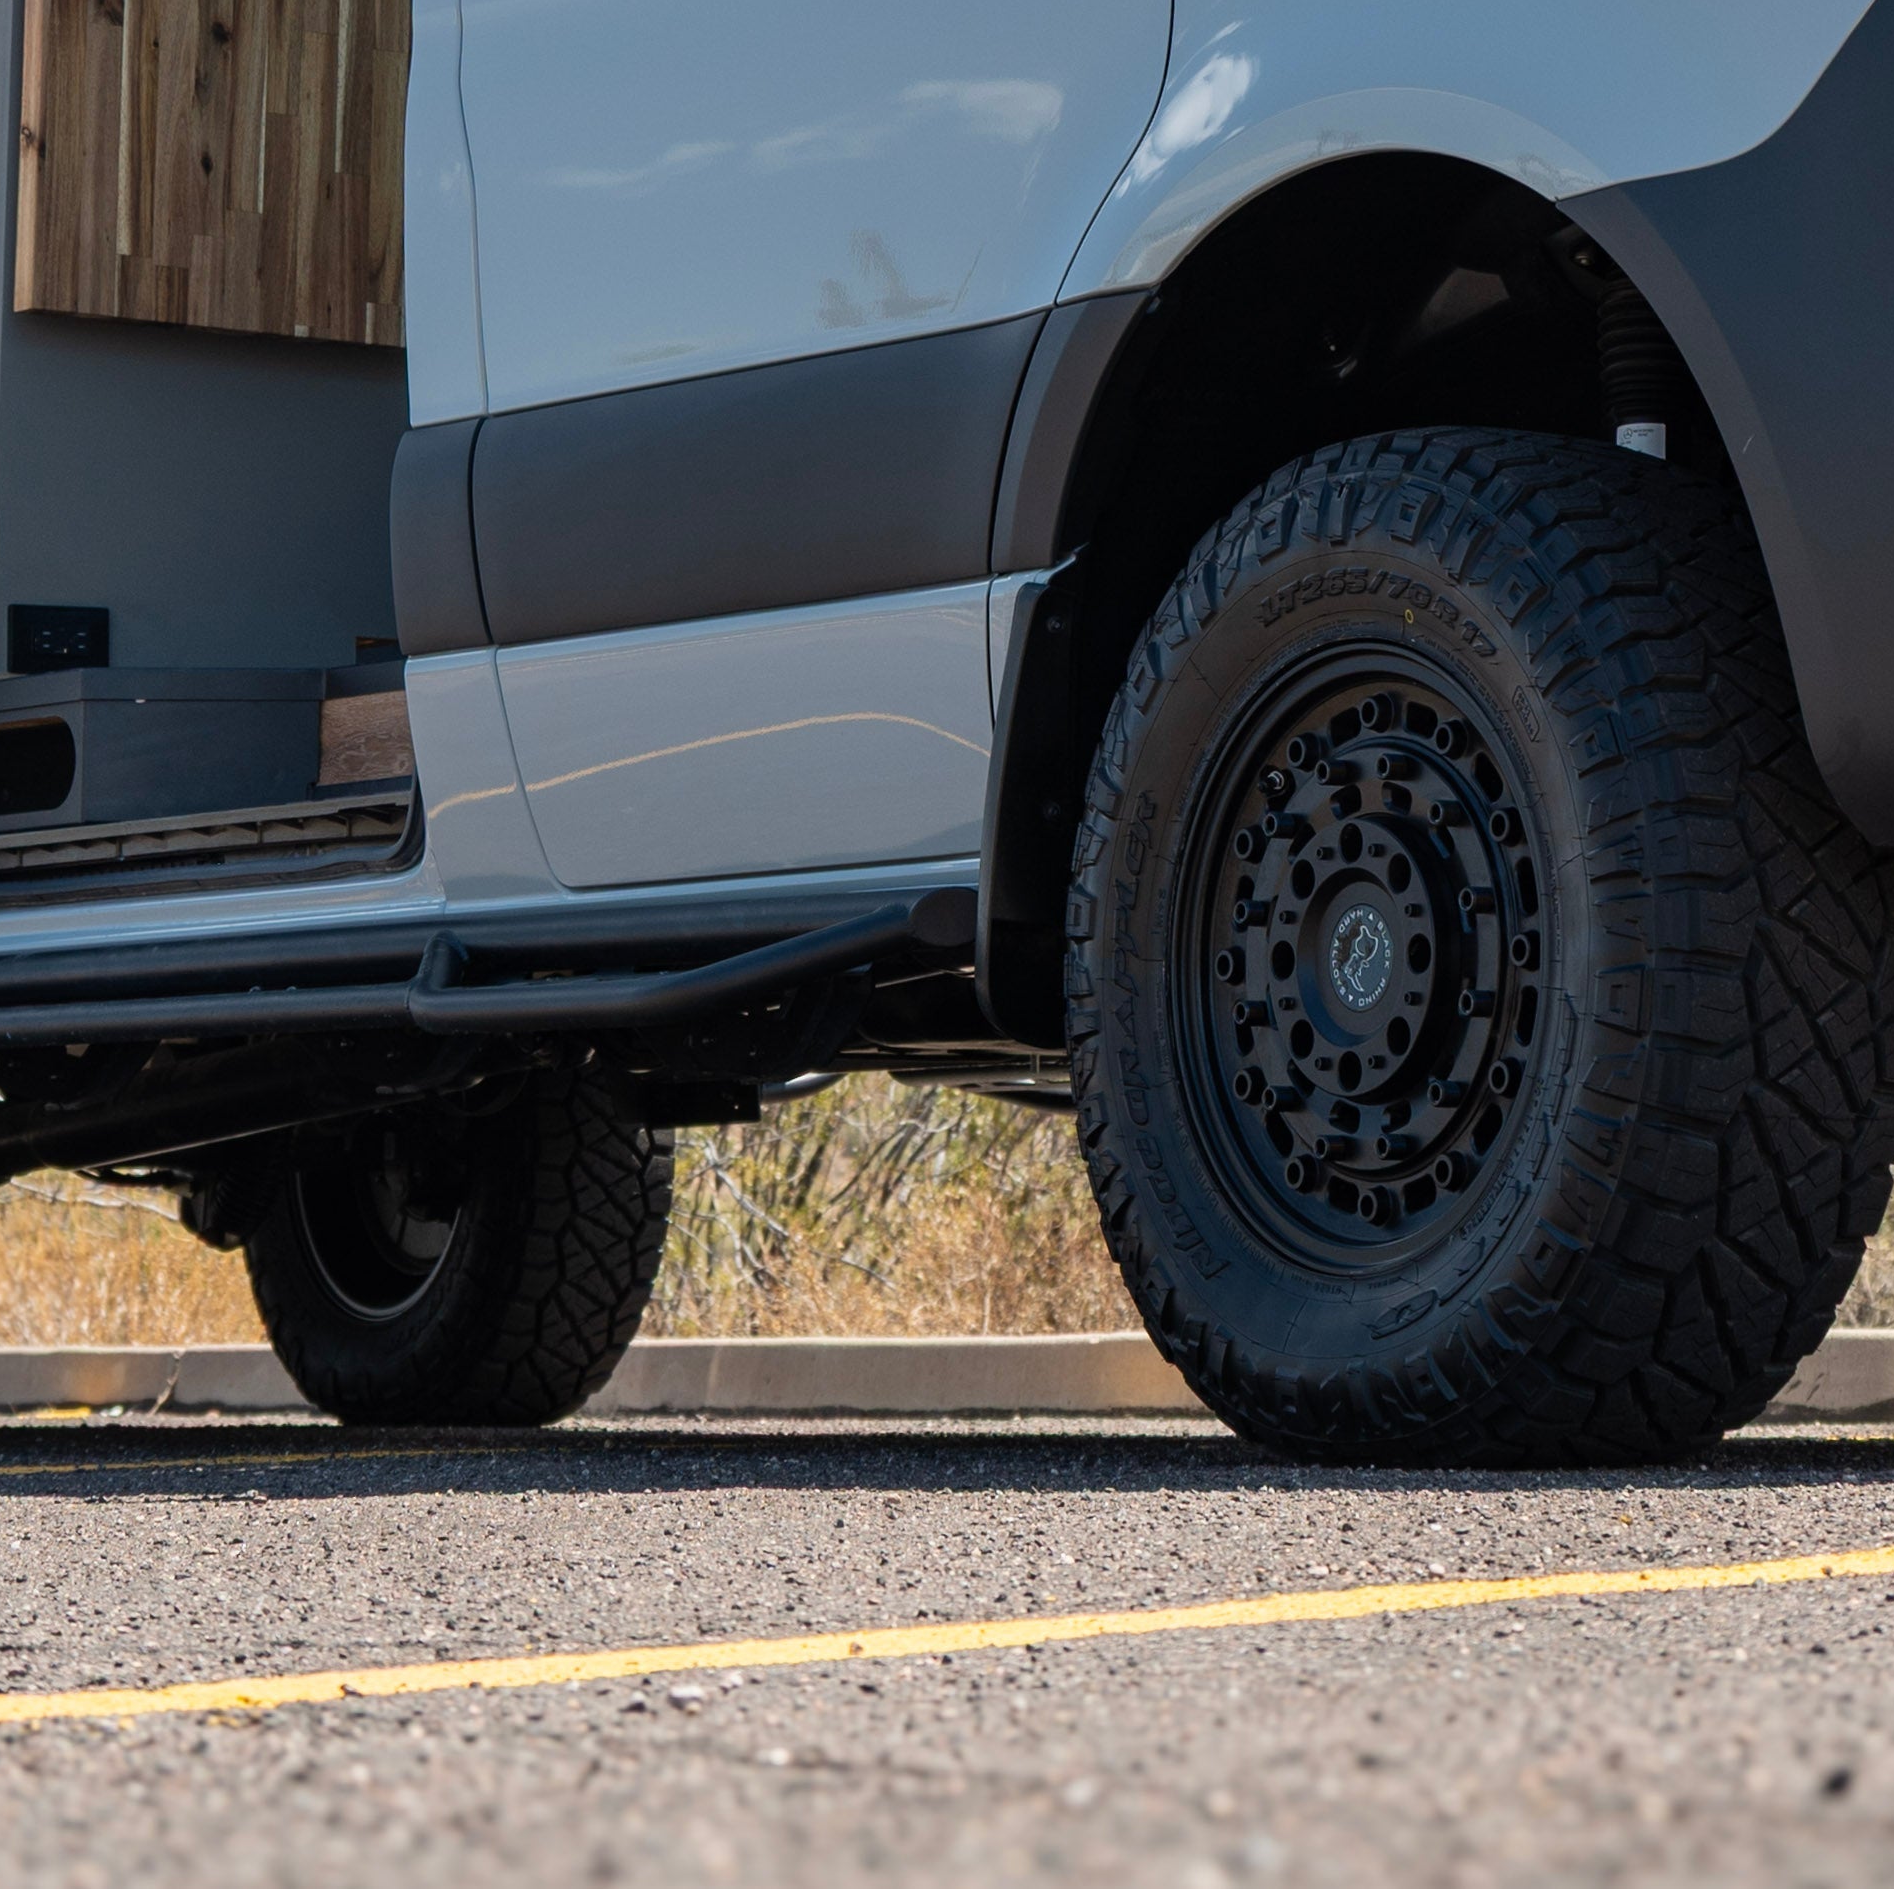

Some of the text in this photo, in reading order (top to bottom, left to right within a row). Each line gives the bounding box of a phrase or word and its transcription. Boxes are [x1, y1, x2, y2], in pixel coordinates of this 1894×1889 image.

[1113, 790, 1157, 1126] GRAPPLER
[1331, 909, 1363, 996] HARD ALLOYS
[1358, 922, 1391, 1007] BLACK RHINO
